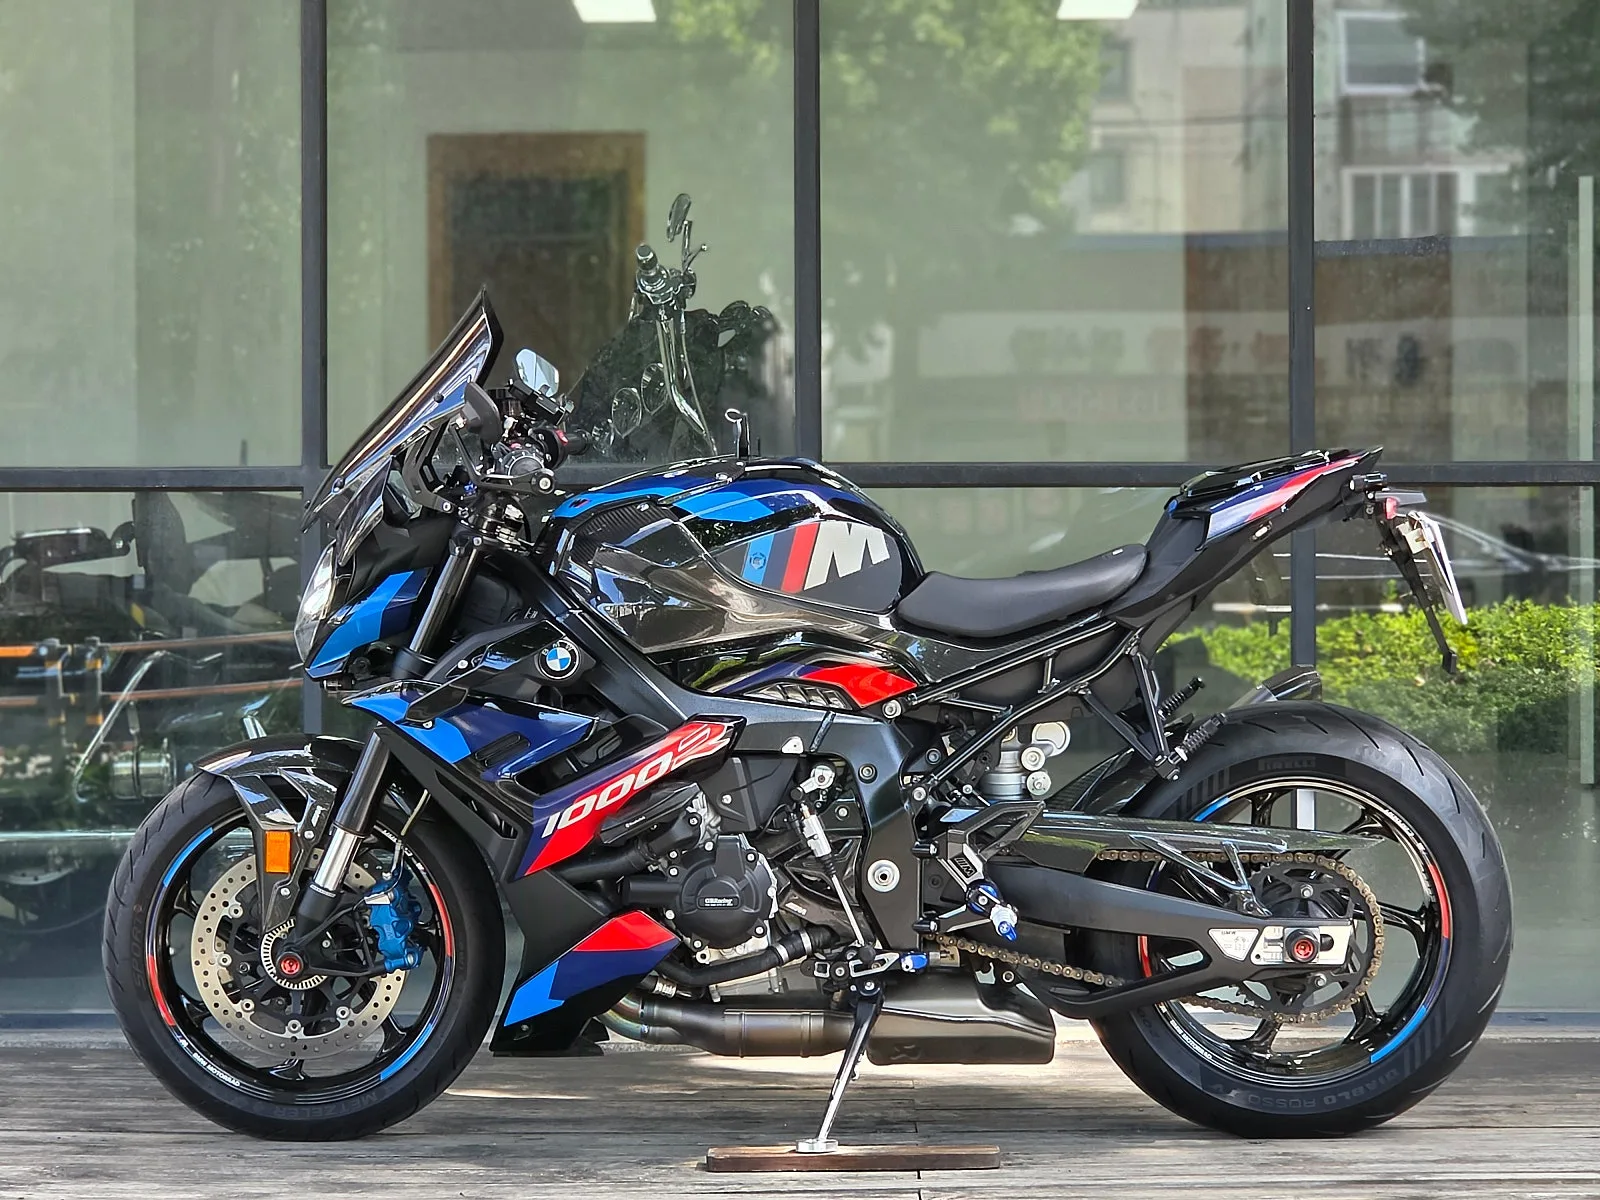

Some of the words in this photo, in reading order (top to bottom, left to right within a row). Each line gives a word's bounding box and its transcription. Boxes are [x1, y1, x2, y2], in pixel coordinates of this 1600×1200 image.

[803, 520, 890, 591] M
[1248, 1093, 1317, 1108] ROSSO
[1323, 1067, 1400, 1105] DIABLO
